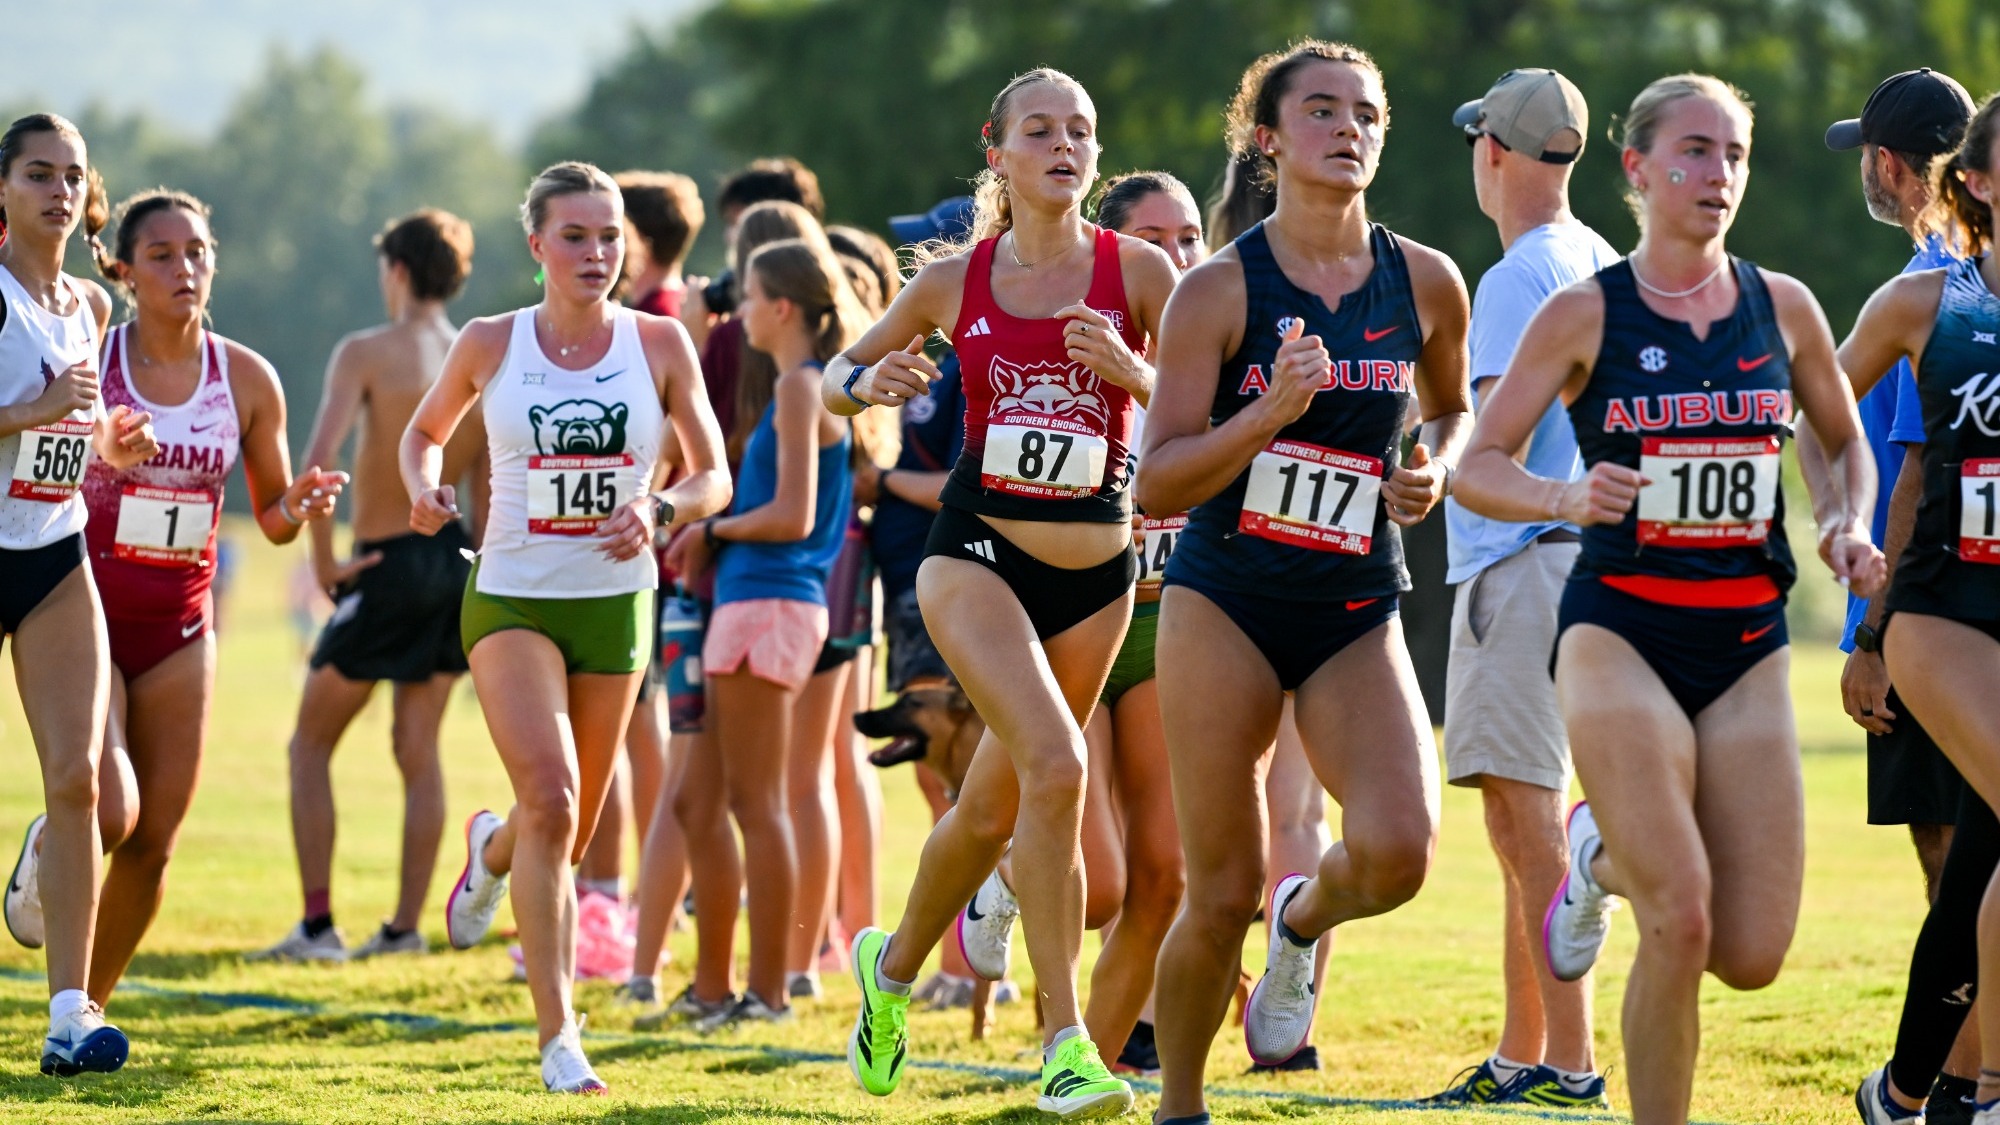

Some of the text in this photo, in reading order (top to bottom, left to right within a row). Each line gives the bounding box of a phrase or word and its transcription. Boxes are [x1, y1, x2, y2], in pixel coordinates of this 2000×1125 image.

[1639, 346, 1668, 371] SEC
[1004, 415, 1096, 435] SOUTHERN SHOWCASE
[33, 435, 86, 482] 568
[1017, 430, 1074, 483] 87
[1272, 442, 1373, 472] SOUTHERN SHOWCASE
[550, 472, 617, 517] 145
[1005, 482, 1043, 494] SEPTEMBER
[1279, 462, 1359, 527] 117
[1671, 460, 1756, 520] 108
[164, 505, 179, 548] 1
[1267, 521, 1310, 537] SEPTEMBER
[1346, 533, 1362, 543] JAX
[1340, 540, 1365, 553] STATE
